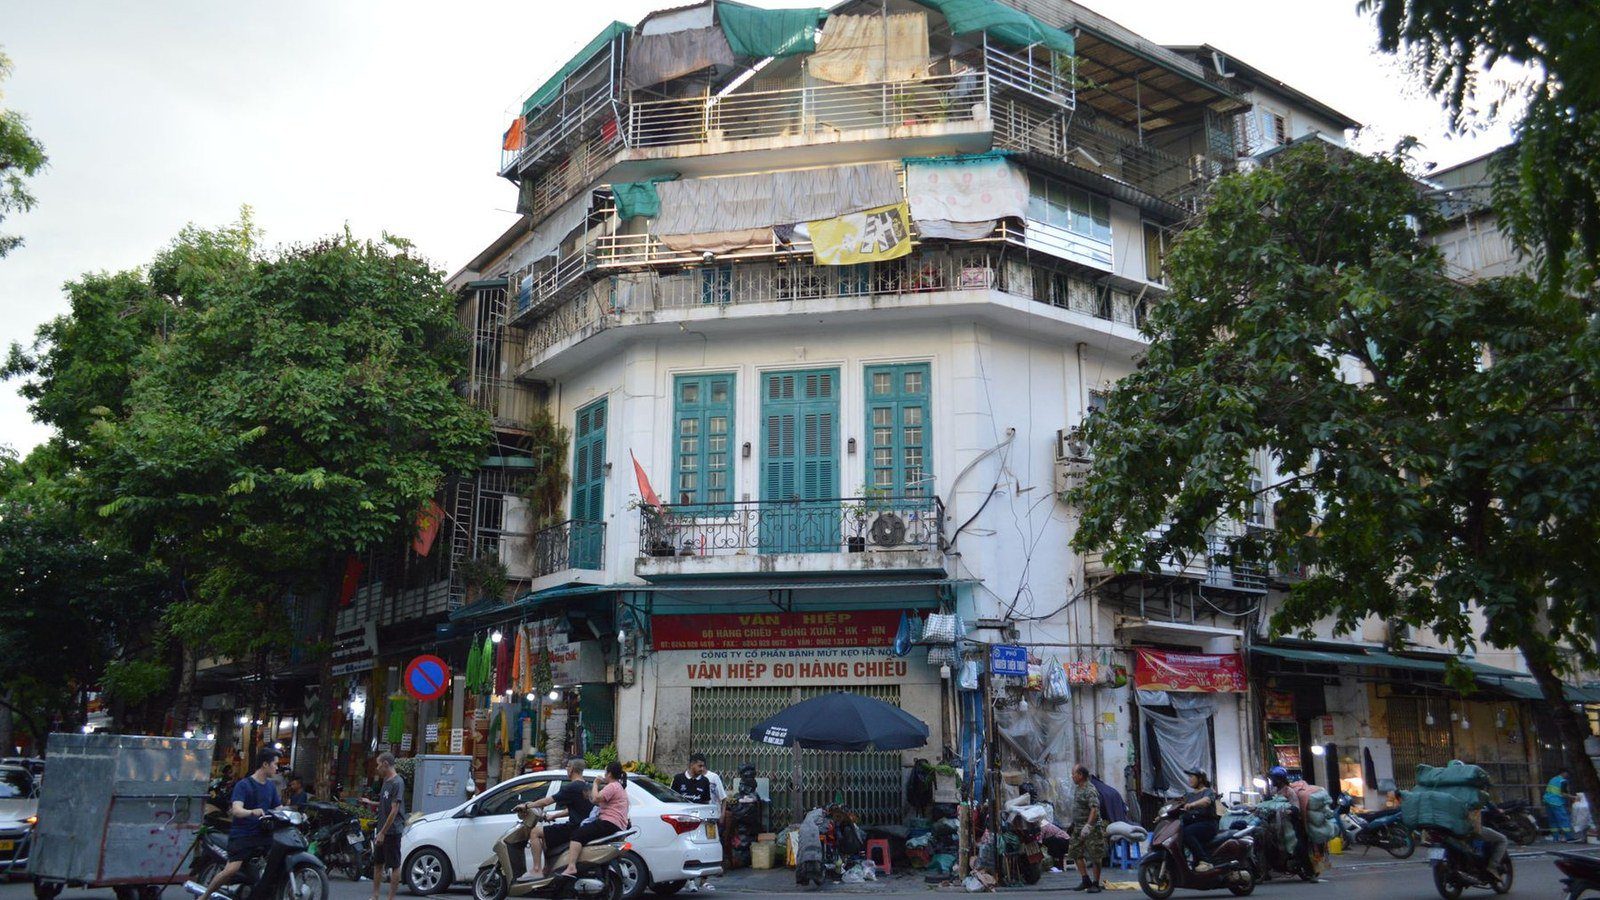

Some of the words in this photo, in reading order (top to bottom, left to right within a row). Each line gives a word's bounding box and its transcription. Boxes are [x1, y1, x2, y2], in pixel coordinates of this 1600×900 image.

[739, 613, 779, 625] VÂN
[803, 612, 852, 624] HIỆP
[701, 649, 728, 659] CÔNG
[730, 650, 742, 659] TY
[688, 661, 721, 679] VÂN
[727, 659, 767, 681] HIỆP
[774, 663, 794, 678] 60
[799, 660, 848, 678] HÀNG
